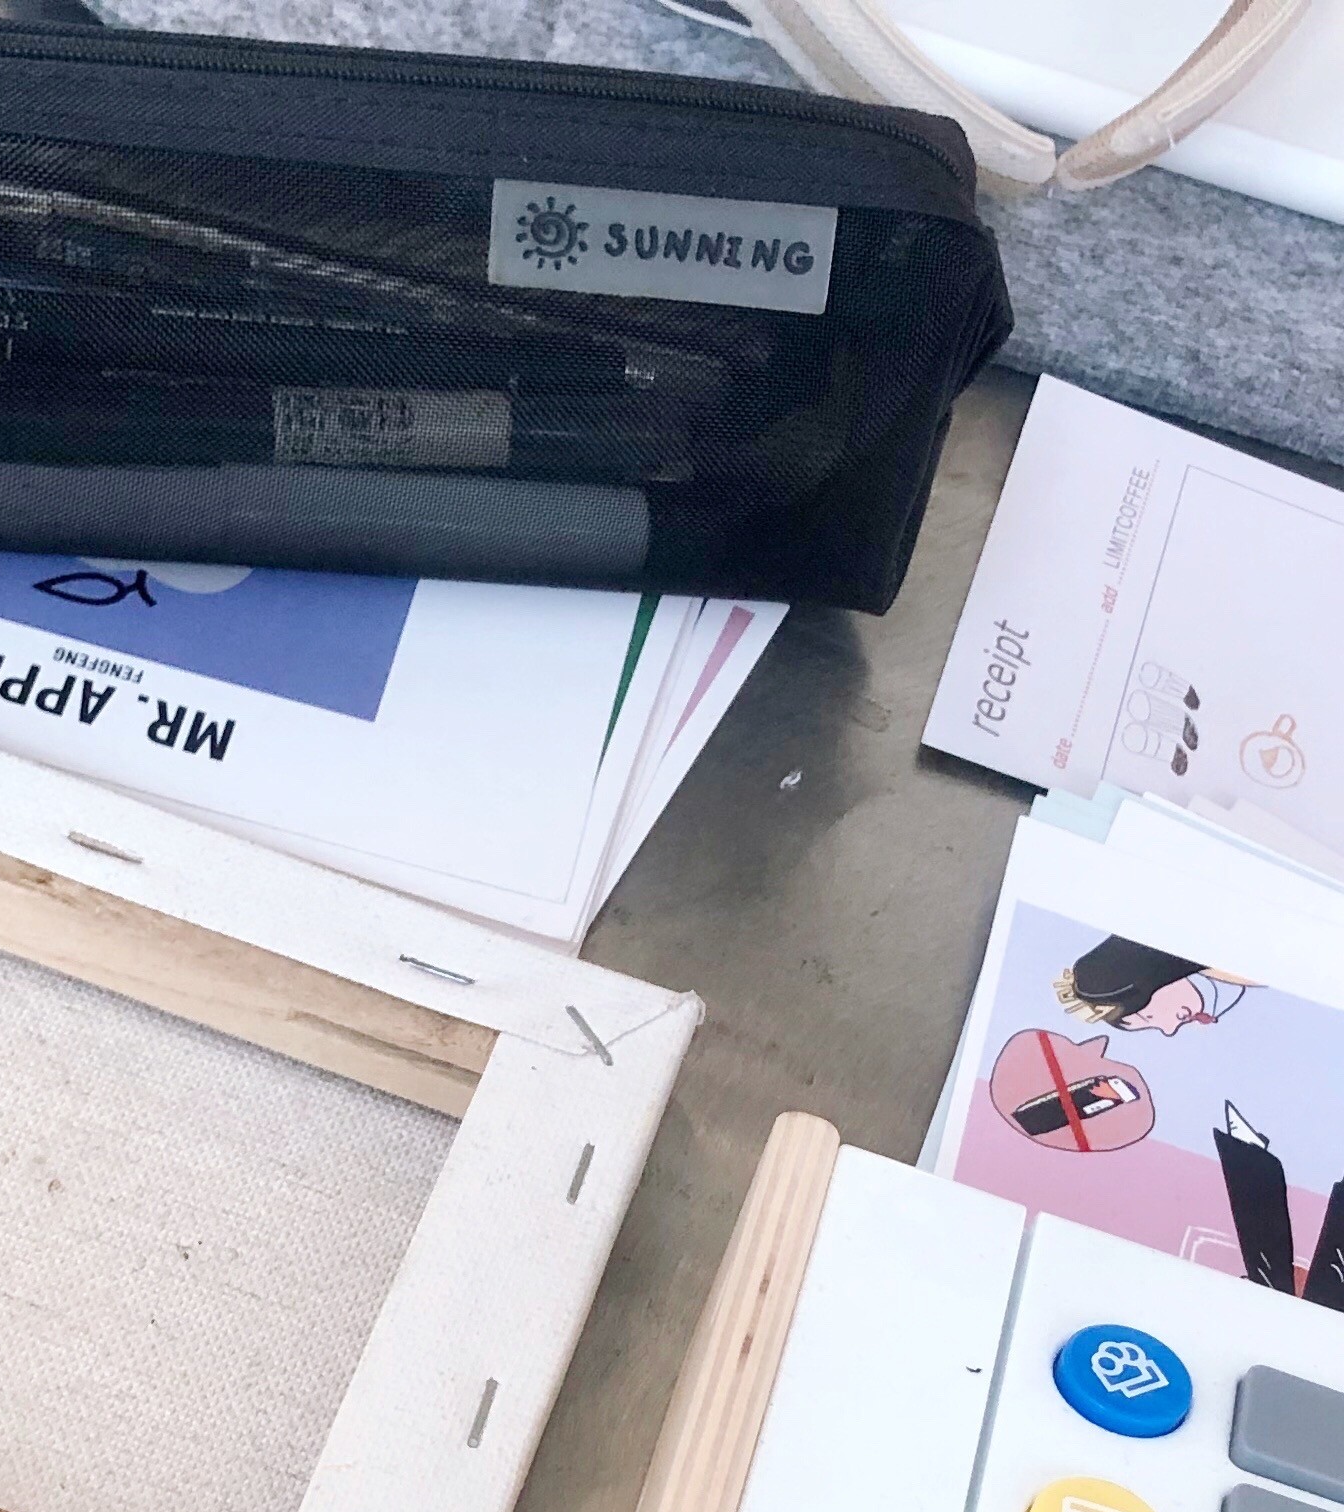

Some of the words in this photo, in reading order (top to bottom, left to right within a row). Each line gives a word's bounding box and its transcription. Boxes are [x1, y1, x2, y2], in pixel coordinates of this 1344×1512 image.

[604, 223, 814, 275] SUNNING
[1102, 465, 1151, 570] LIMITCOFFEE
[1100, 583, 1120, 614] add
[53, 647, 144, 683] FENGFENG
[972, 618, 1031, 738] receipt
[138, 694, 236, 762] MR.
[1053, 737, 1073, 769] date
